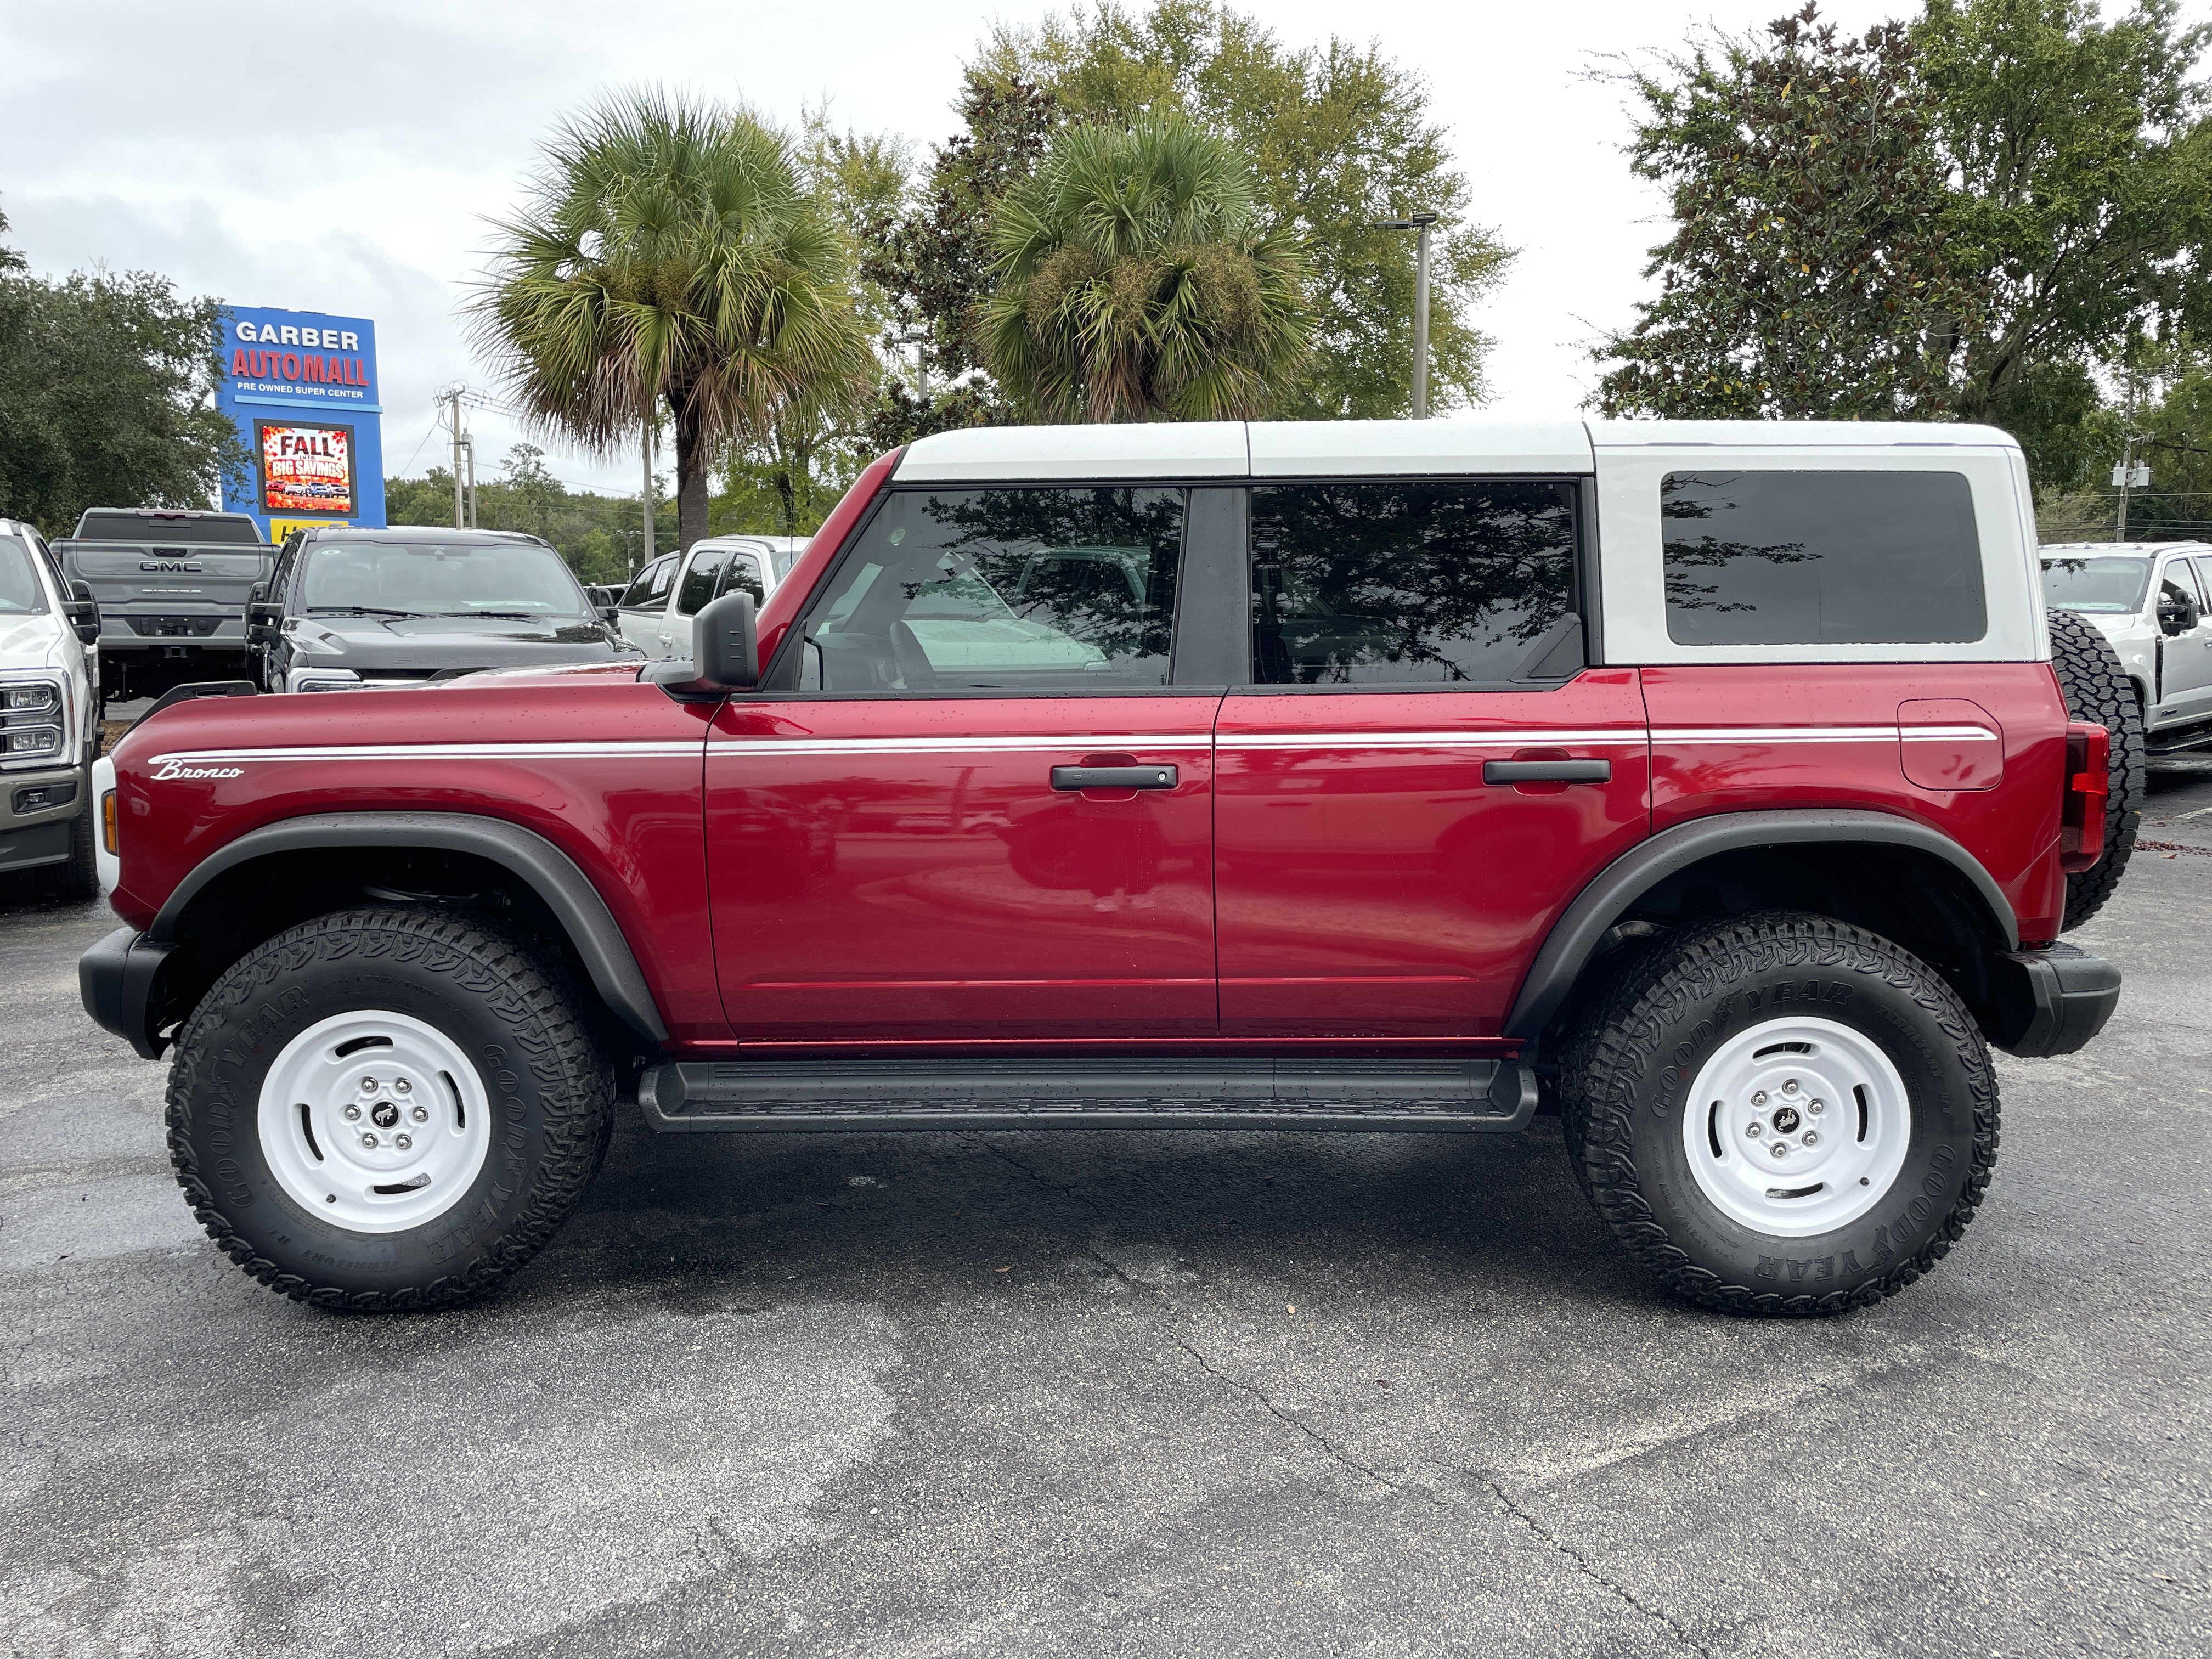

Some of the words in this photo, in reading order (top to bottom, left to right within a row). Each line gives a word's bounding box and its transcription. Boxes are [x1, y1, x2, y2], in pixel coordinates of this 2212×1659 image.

[236, 321, 359, 351] GARBER
[232, 348, 369, 387] AUTOMALL
[237, 382, 257, 391] PRE
[258, 383, 293, 393] OWNED
[295, 386, 325, 396] SUPER
[328, 388, 363, 399] CENTER
[280, 435, 335, 458] FALL
[272, 460, 294, 477] BIG
[295, 461, 346, 479] SAVINGS
[139, 560, 202, 572] GMC
[150, 759, 245, 781] Bronco
